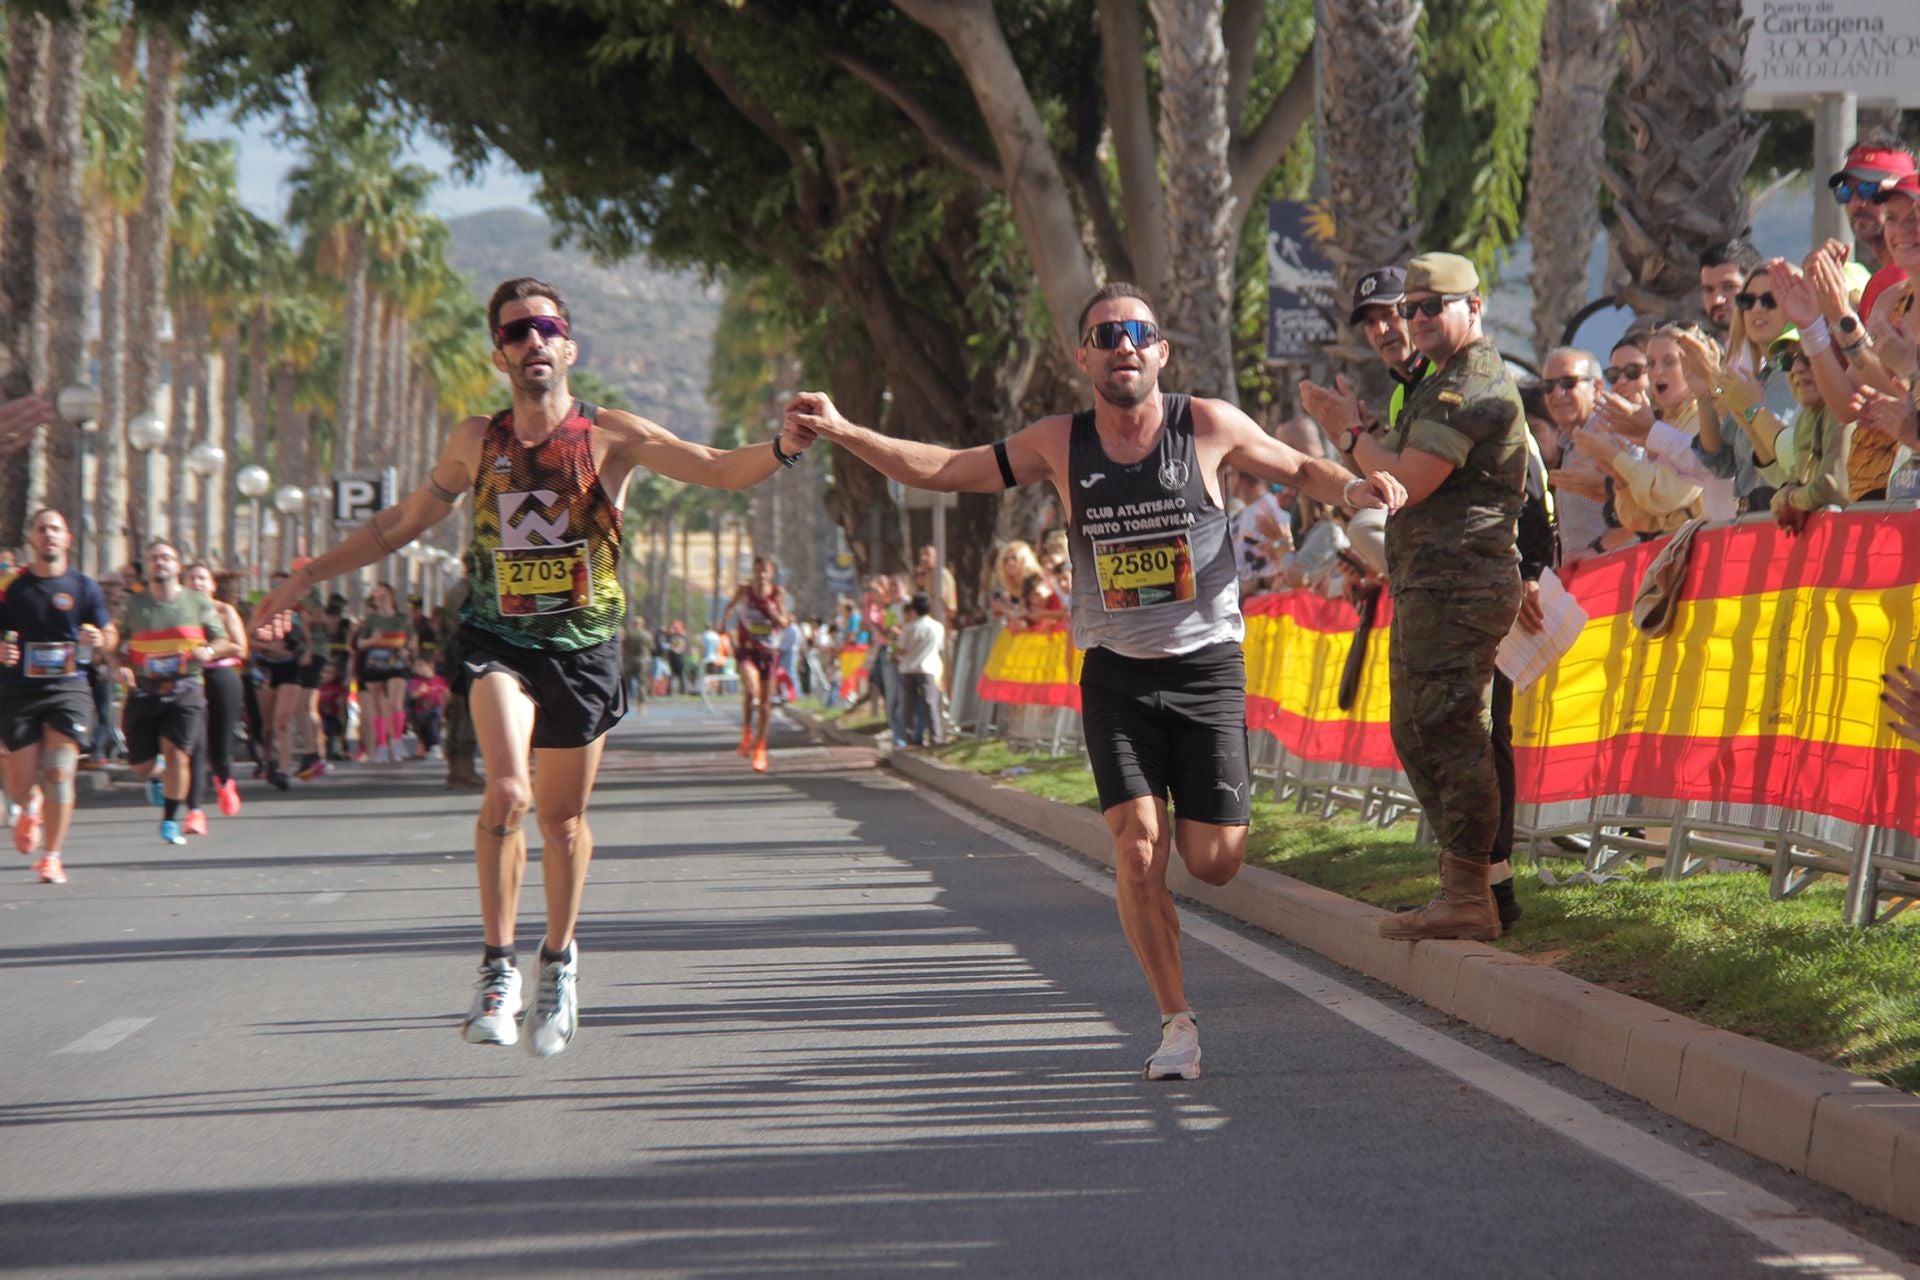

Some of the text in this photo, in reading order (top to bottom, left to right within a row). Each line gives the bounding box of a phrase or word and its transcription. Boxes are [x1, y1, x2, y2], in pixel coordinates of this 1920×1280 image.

[1763, 0, 1834, 17] Puerto de
[1763, 15, 1885, 38] Cartagena
[338, 480, 375, 520] P
[1085, 496, 1186, 520] CLUB ATLETISMO
[1081, 511, 1197, 537] PUERTO TORREVIEJA
[510, 559, 567, 583] 2703
[1110, 549, 1169, 576] 2580
